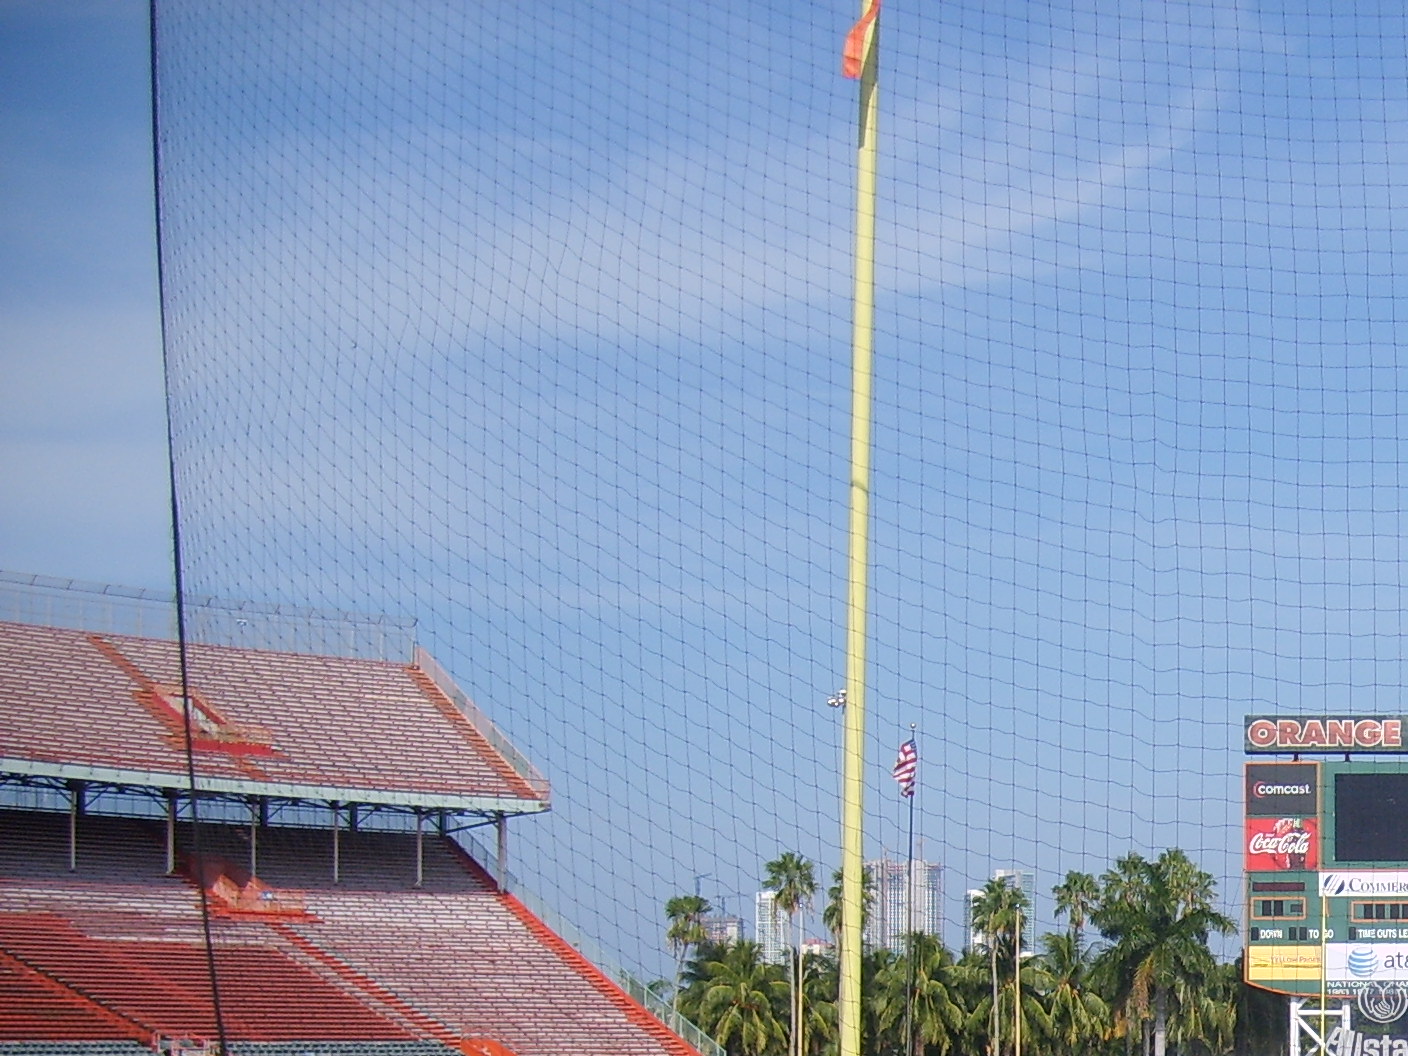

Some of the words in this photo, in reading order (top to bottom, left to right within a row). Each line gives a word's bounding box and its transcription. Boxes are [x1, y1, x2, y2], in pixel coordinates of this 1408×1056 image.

[1249, 720, 1402, 747] ORANGE
[1257, 783, 1312, 795] comcast
[1260, 929, 1283, 939] DOWN
[1308, 929, 1320, 939] TO
[1357, 929, 1376, 939] TIME
